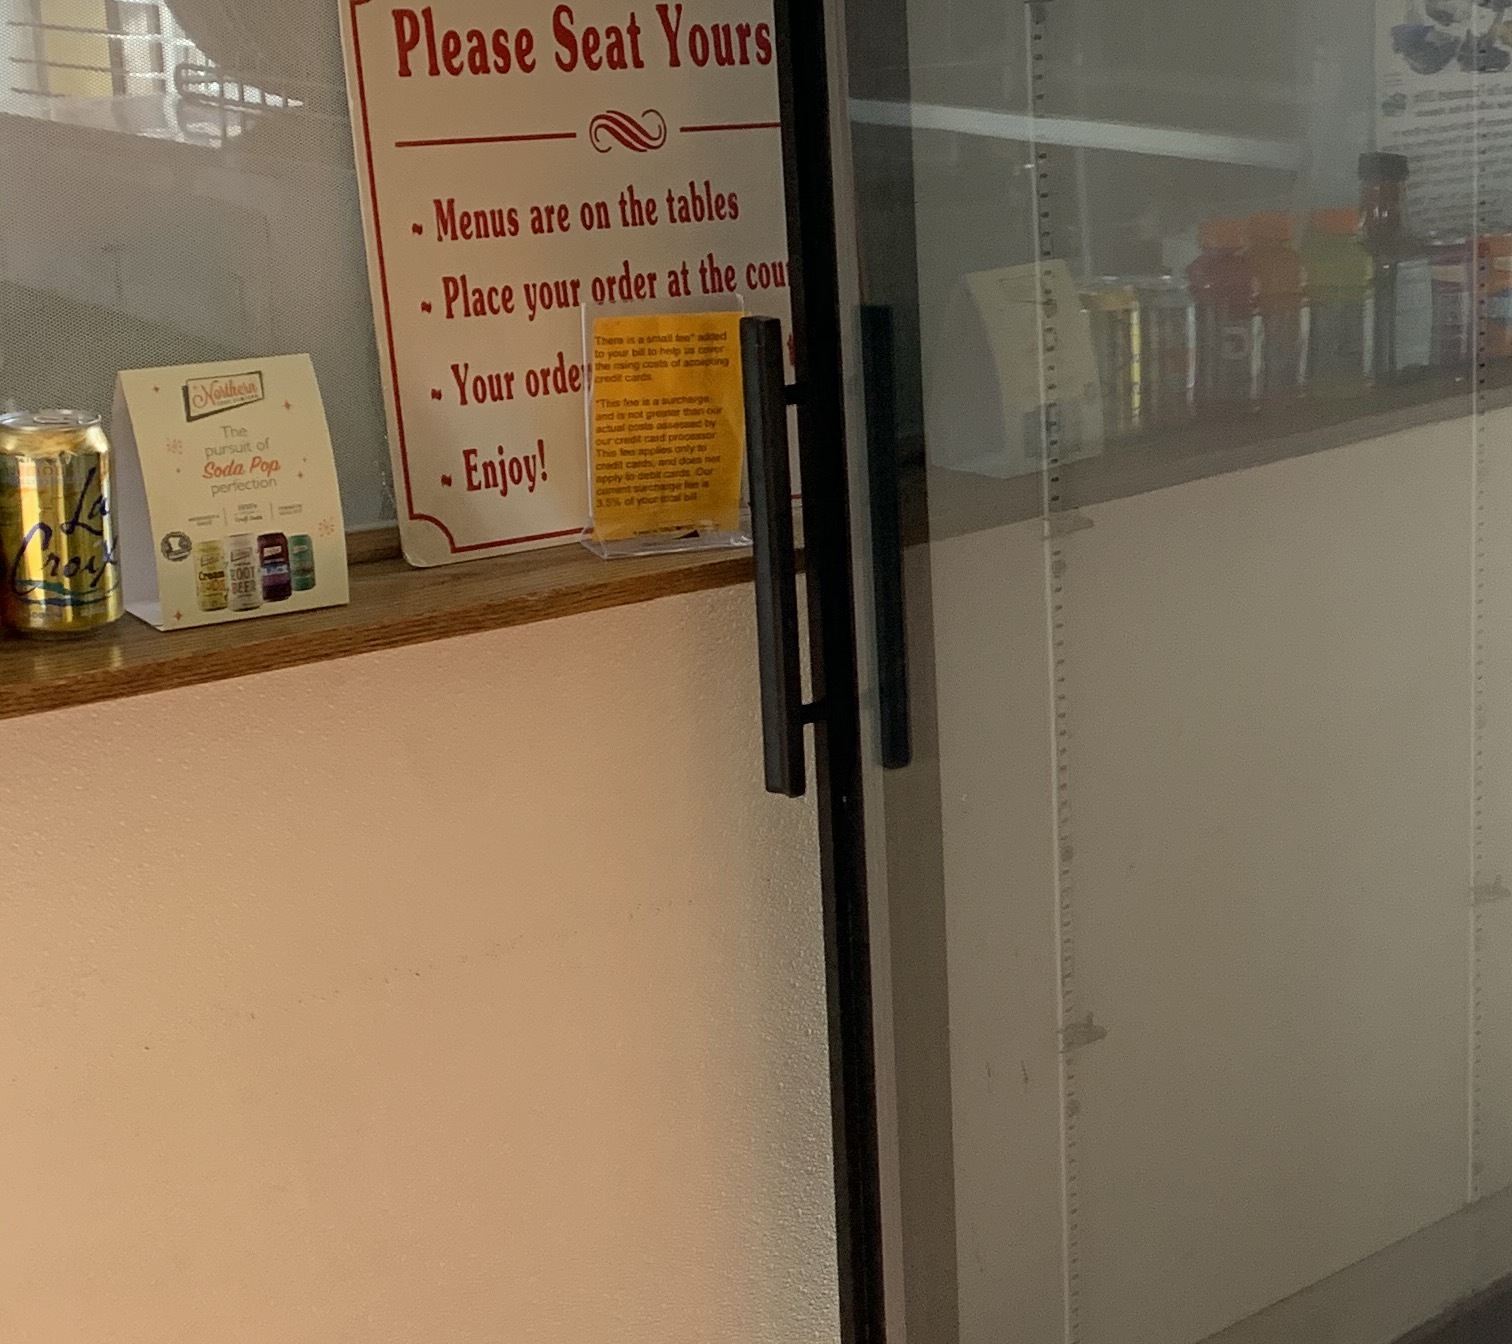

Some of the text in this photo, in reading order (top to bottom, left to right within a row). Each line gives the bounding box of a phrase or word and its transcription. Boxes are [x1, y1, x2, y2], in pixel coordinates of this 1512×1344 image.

[392, 3, 773, 77] Please Seat Yours
[433, 179, 739, 242] Menus are on the tables
[442, 274, 515, 320] Place
[523, 280, 580, 321] your
[591, 259, 657, 304] order
[667, 260, 692, 298] at
[699, 253, 737, 293] the
[450, 362, 515, 406] Your
[204, 438, 270, 459] pursuit of
[220, 426, 247, 437] The
[202, 456, 280, 479] Soda Pop
[211, 478, 277, 497] perfection
[462, 439, 548, 497] Enjoy!
